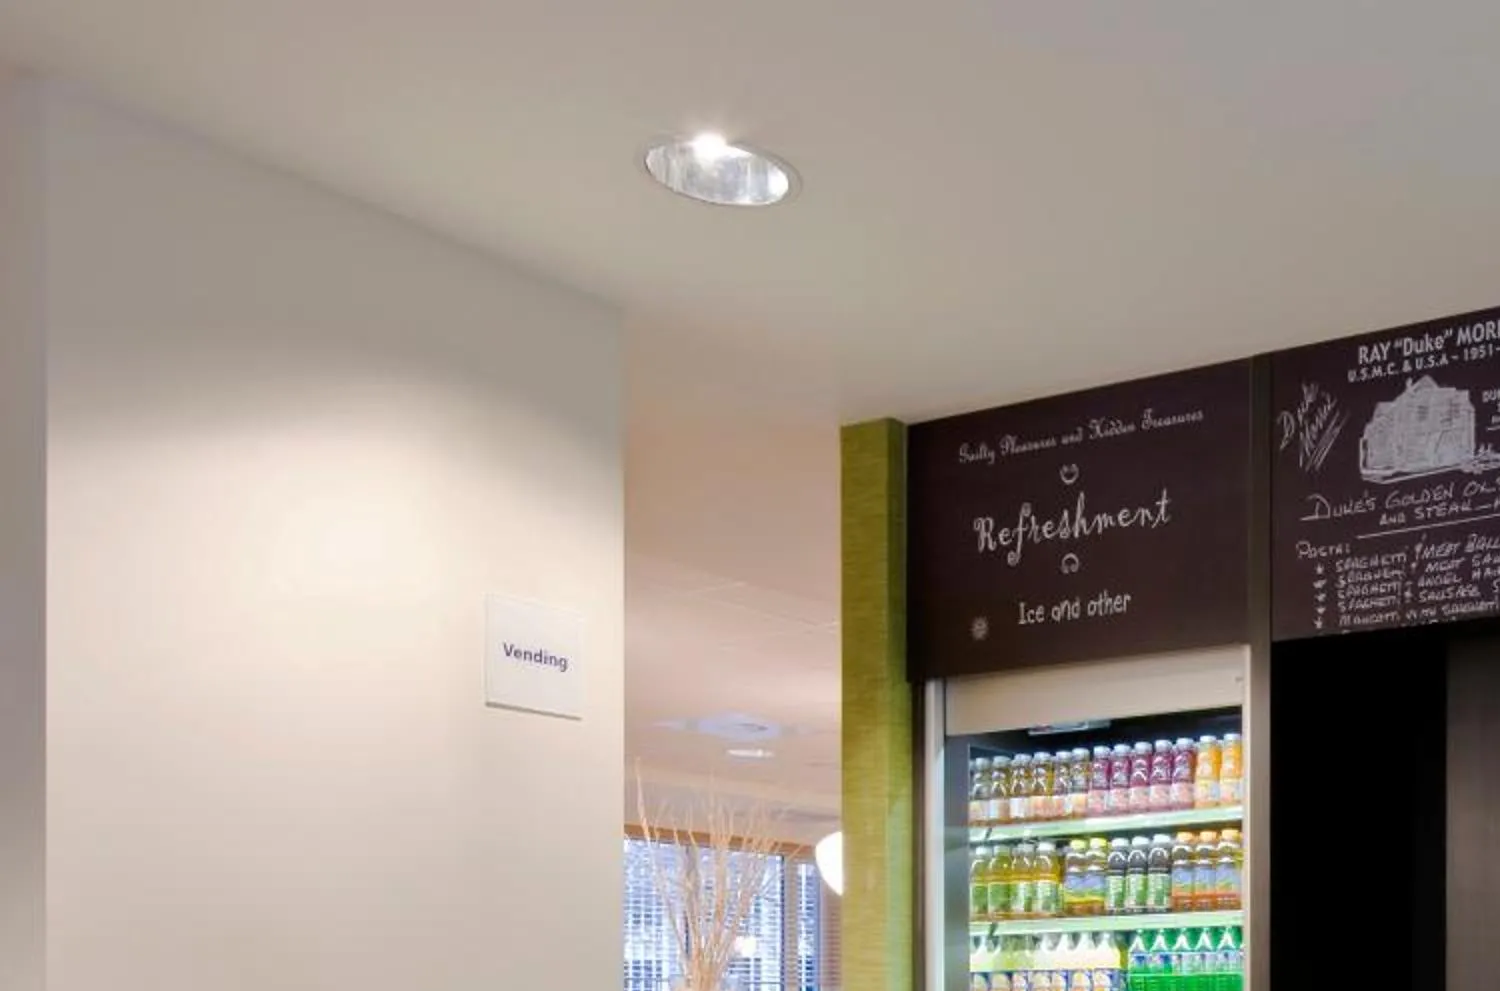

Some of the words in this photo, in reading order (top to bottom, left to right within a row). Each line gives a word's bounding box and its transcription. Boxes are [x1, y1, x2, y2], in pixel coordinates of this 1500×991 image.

[1358, 341, 1391, 365] RAY
[1061, 427, 1083, 445] and
[973, 488, 1171, 567] Refreshment
[1018, 601, 1045, 625] Ice
[1051, 596, 1080, 621] and
[1087, 588, 1132, 616] other
[503, 642, 569, 673] Vending
